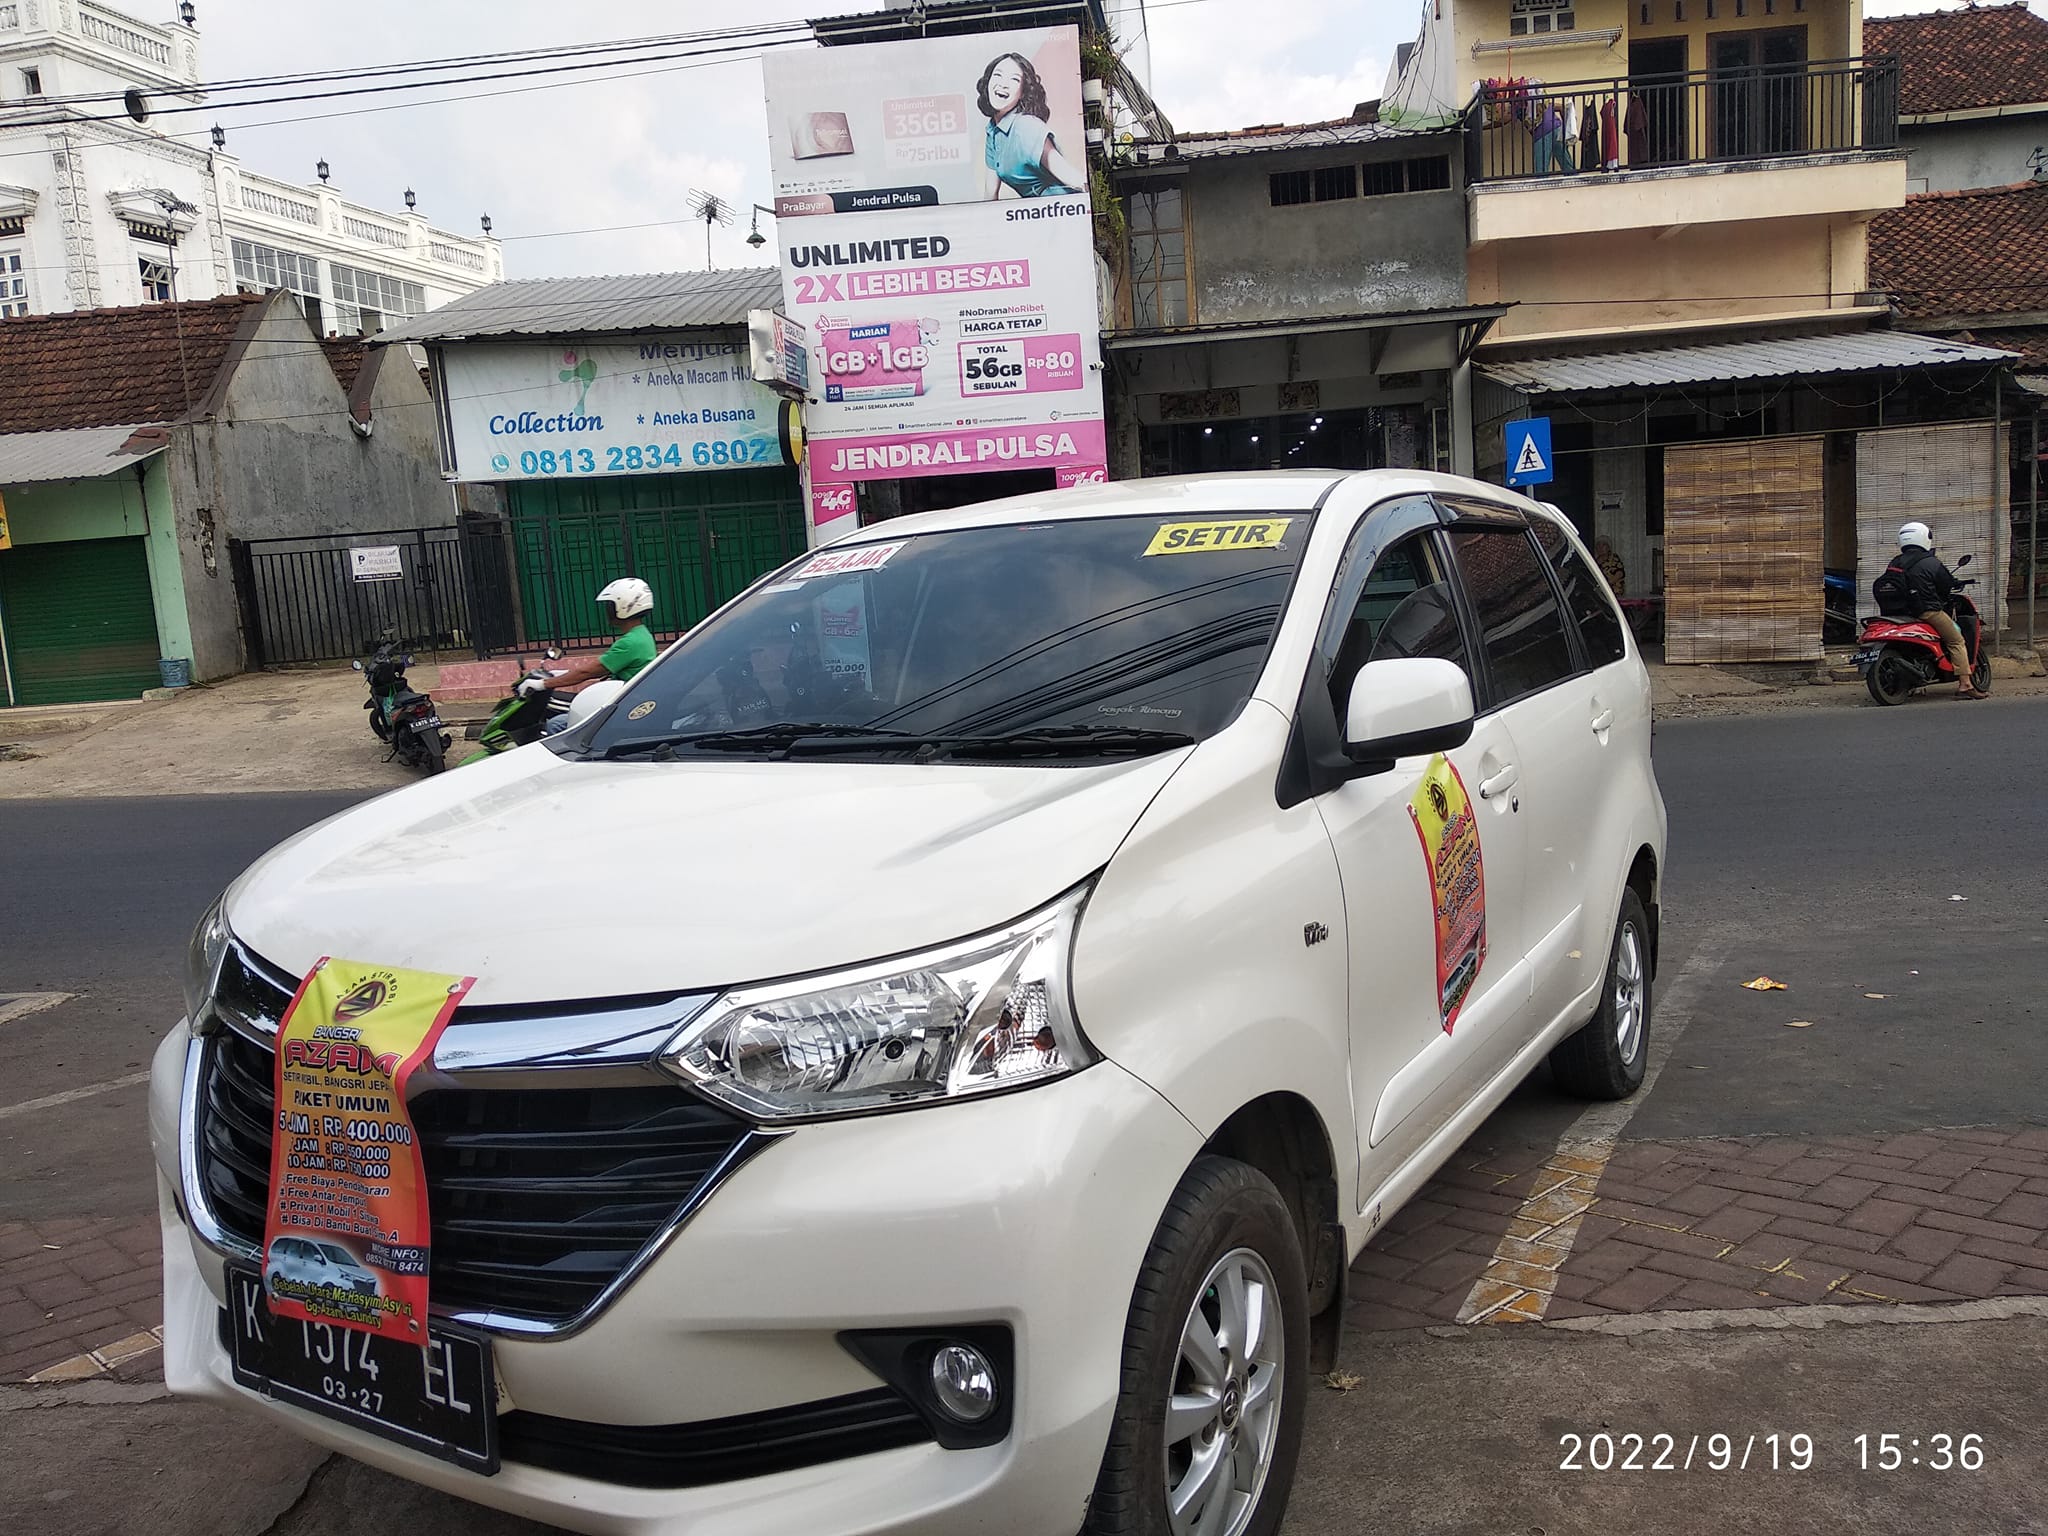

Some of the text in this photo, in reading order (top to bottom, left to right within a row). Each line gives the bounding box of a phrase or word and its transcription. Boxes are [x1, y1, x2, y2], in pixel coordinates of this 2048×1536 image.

[894, 111, 957, 136] 35GB
[782, 202, 825, 213] PraBayar
[851, 193, 922, 207] Jendral Pulsa
[789, 235, 951, 268] UNLIMITED
[793, 264, 1025, 305] 2X LEBIH BESAR
[851, 327, 888, 338] HARIAN
[963, 318, 1042, 333] HARGA TETAP
[977, 345, 1008, 354] TOTAL
[647, 371, 685, 387] Aneka
[686, 368, 728, 385] Macam
[973, 380, 1017, 391] SEBULAN
[828, 387, 840, 395] 28
[488, 411, 604, 436] Collection
[653, 408, 756, 426] Aneka Busana
[520, 438, 769, 475] 0813 2834 6802
[830, 432, 1079, 472] JENDRAL PULSA
[1163, 524, 1271, 549] SETIR
[800, 546, 894, 575] BELAJAR
[313, 1025, 363, 1041] BANGSRI
[285, 1039, 403, 1080] AZAM
[324, 1076, 366, 1089] BANGSRI
[335, 1095, 391, 1114] UMUM
[280, 1110, 287, 1130] 5
[294, 1139, 319, 1152] JAM
[288, 1154, 300, 1168] 10
[303, 1155, 325, 1170] JAM
[286, 1173, 309, 1185] Free
[311, 1175, 335, 1188] Biaya
[287, 1187, 309, 1198] Free
[311, 1189, 336, 1201] Antar
[289, 1201, 317, 1213] Privat
[326, 1205, 351, 1217] Mobil
[291, 1214, 311, 1226] Bisa
[314, 1216, 325, 1227] Di
[326, 1218, 351, 1231] Bantu
[387, 1230, 399, 1243] A
[365, 1253, 383, 1265] 0852
[398, 1261, 424, 1272] 8474
[391, 1248, 419, 1259] INFO
[273, 1277, 306, 1294] Sebelah
[308, 1282, 331, 1297] Utara
[344, 1307, 382, 1329] Laundry
[242, 1280, 264, 1343] K
[421, 1340, 472, 1415] EL
